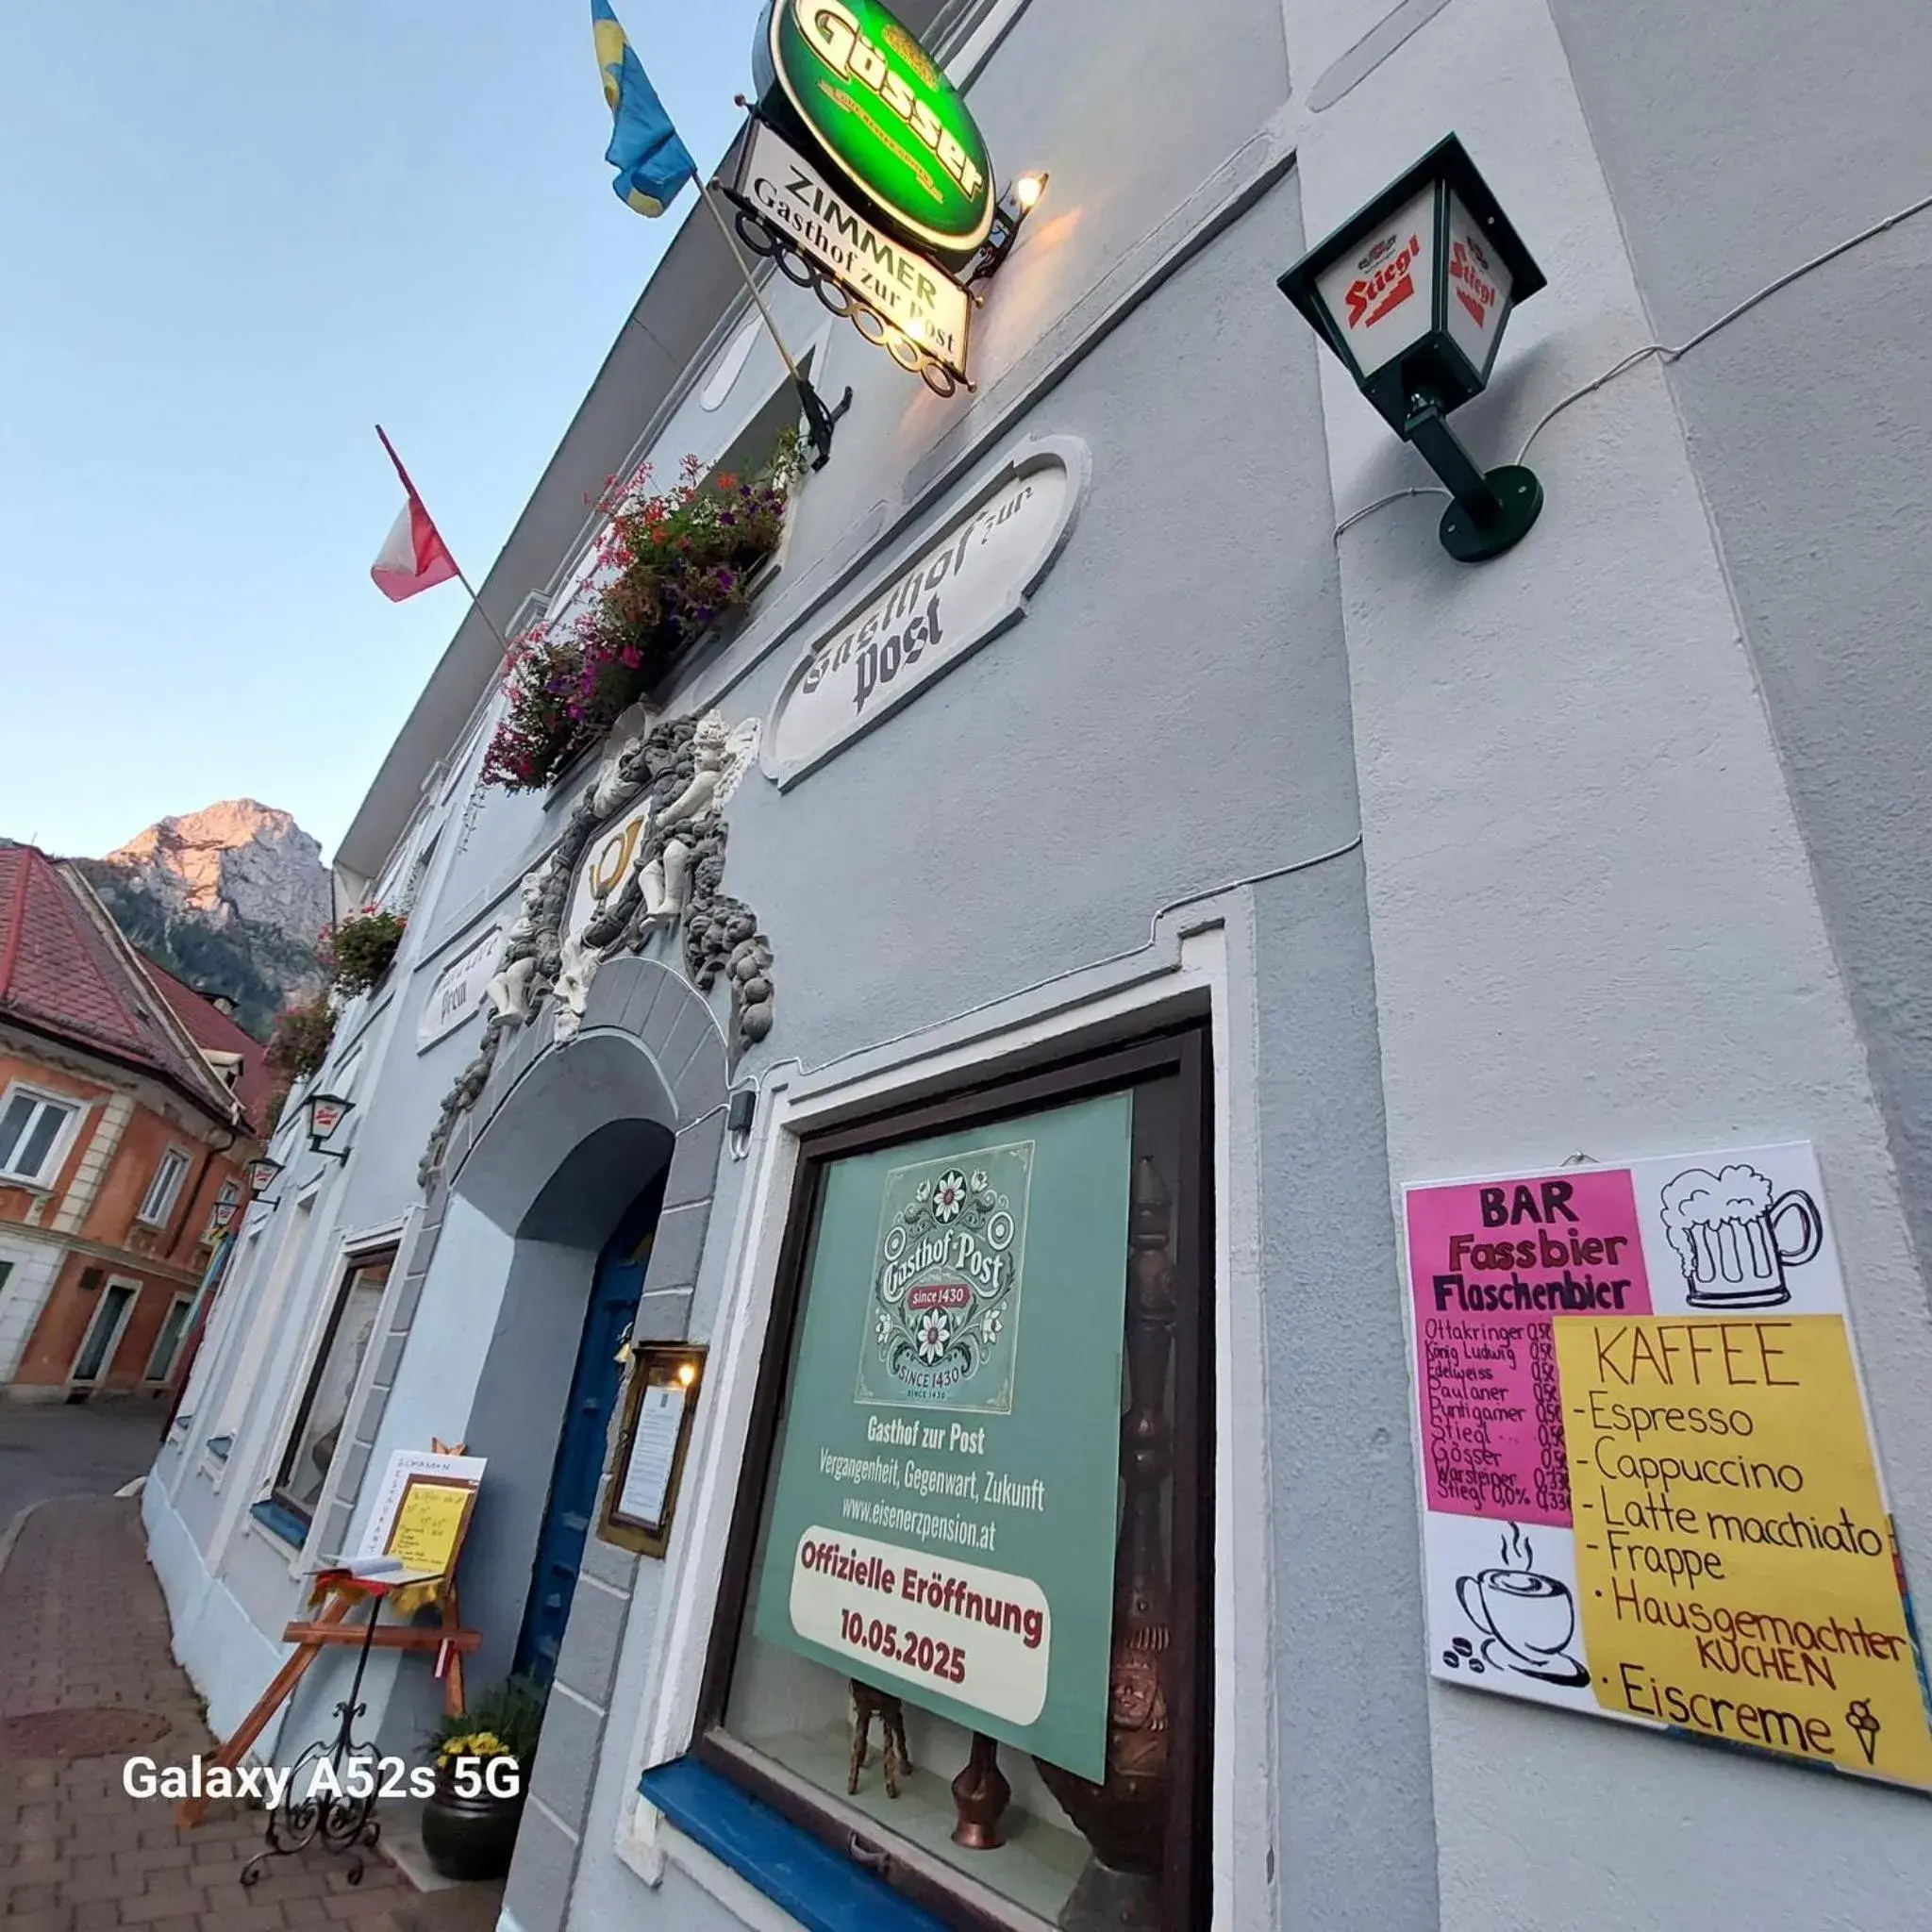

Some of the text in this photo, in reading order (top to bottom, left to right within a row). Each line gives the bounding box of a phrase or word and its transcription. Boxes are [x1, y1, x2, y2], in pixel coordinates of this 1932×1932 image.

[795, 0, 983, 204] Gösser
[785, 164, 937, 309] ZIMMER
[755, 177, 955, 354] Gasthof zur Post
[1345, 234, 1420, 329] Stiegl
[1449, 242, 1495, 308] Stiegl
[981, 486, 1034, 545] zur
[1480, 1180, 1579, 1227] BAR
[882, 1228, 1004, 1303] Gasthof Post
[1449, 1228, 1628, 1272] Fassbier
[912, 1288, 963, 1305] since 1430
[1433, 1271, 1631, 1311] Flaschenbier
[1424, 1340, 1459, 1367] König
[1462, 1341, 1517, 1370] Ludwig
[1425, 1318, 1524, 1348] Ottakringer
[1594, 1323, 1800, 1387] KAFFEE
[898, 1366, 959, 1388] SINCE 1430
[1427, 1358, 1493, 1381] Edelweiss
[1428, 1375, 1508, 1402] Paulaner
[867, 1415, 985, 1455] Gasthof zur Post
[1429, 1396, 1526, 1427] Puntigamer
[1431, 1416, 1491, 1450] Stiegl
[1431, 1439, 1502, 1467] Gösser
[1434, 1460, 1517, 1487] Warsteiner
[820, 1447, 1045, 1511] Vergangenheit, Gegenwart, Zukunft
[1437, 1477, 1486, 1510] Stiegl
[842, 1497, 996, 1551] www.eisenerzpension.at
[1708, 1507, 1883, 1557] macchiato
[801, 1541, 1044, 1649] Offizielle Eröffnung
[1612, 1576, 1907, 1662] Hausgemachter
[841, 1608, 966, 1684] 10.05.2025
[1620, 1663, 1836, 1755] Eiscreme
